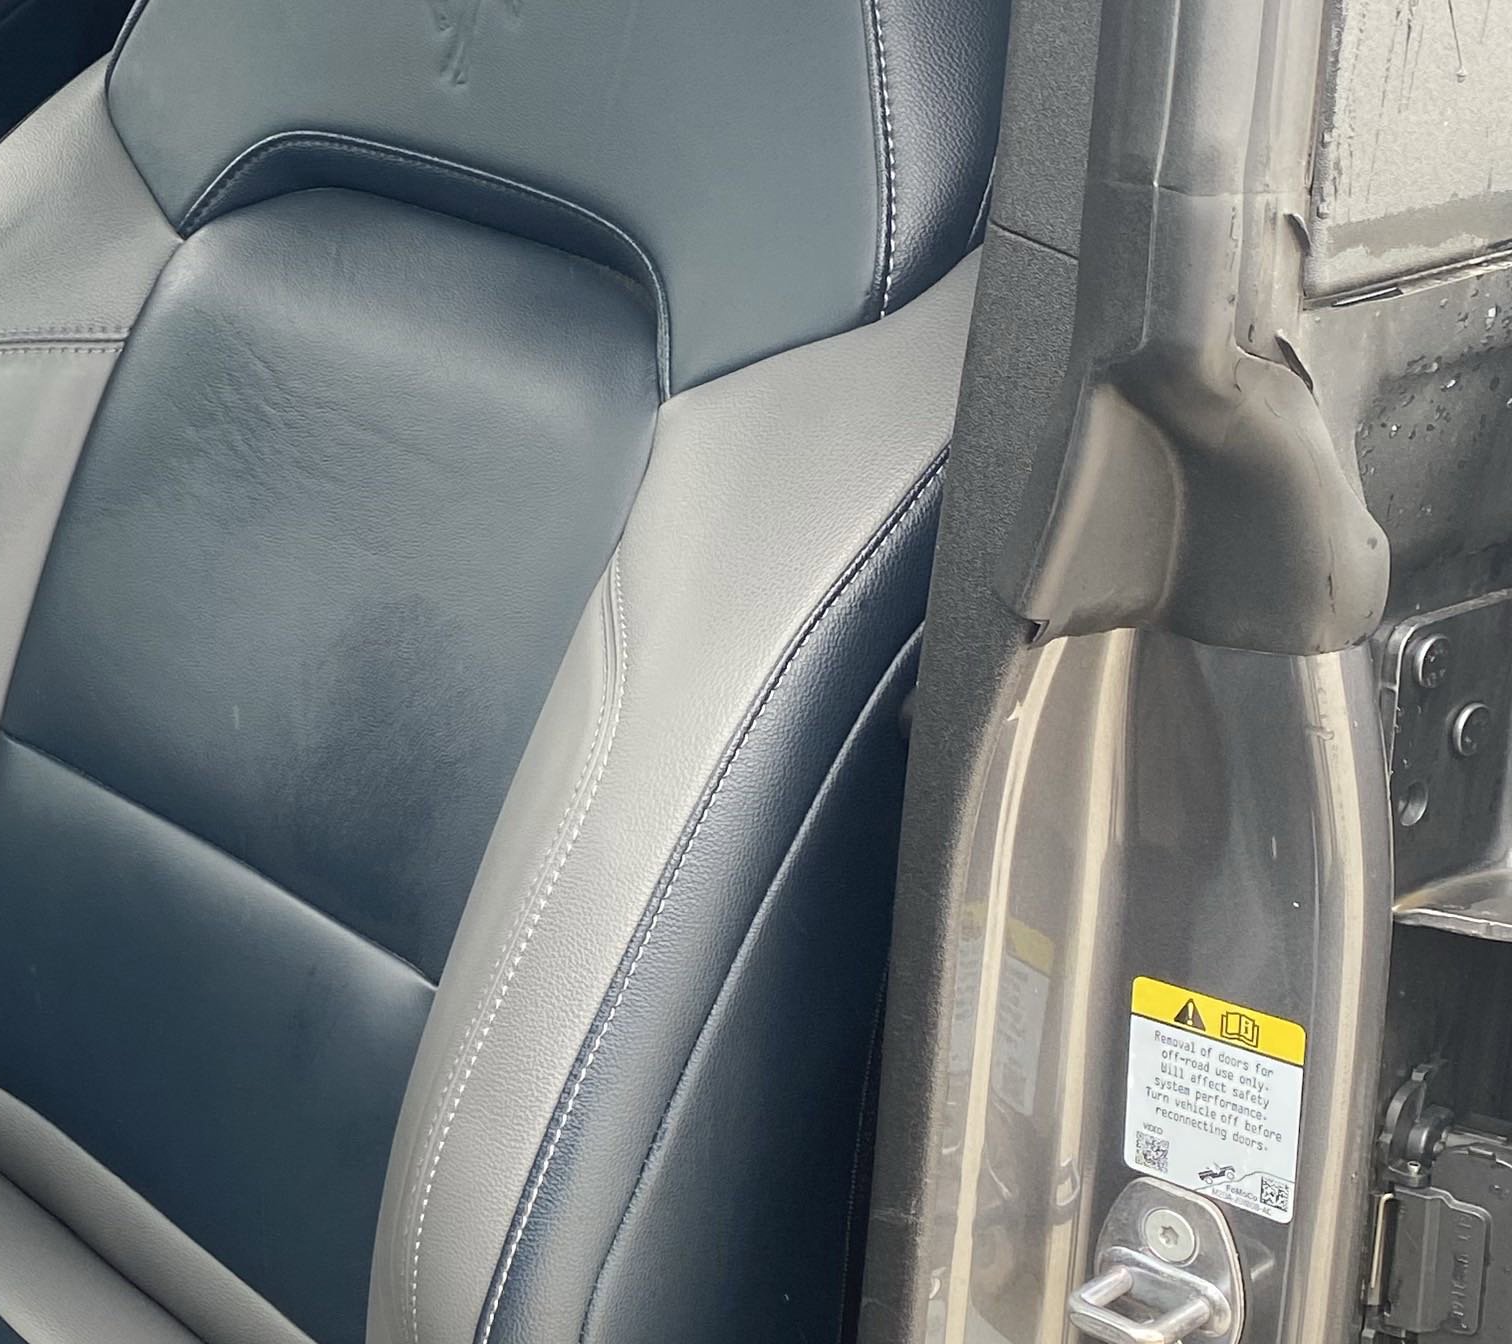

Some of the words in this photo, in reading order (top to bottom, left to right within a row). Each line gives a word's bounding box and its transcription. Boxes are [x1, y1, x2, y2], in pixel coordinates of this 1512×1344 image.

[1154, 1029, 1196, 1054] Removal
[1200, 1044, 1212, 1059] of
[1218, 1051, 1249, 1071] doors
[1255, 1063, 1274, 1079] for
[1161, 1048, 1209, 1073] off-road
[1215, 1066, 1233, 1081] use
[1154, 1075, 1190, 1098] system
[1190, 1072, 1225, 1093] affect
[1232, 1085, 1270, 1110] safety
[1145, 1085, 1169, 1104] Turn
[1175, 1095, 1216, 1120] vehicle
[1220, 1111, 1237, 1128] off
[1244, 1119, 1282, 1143] before
[1155, 1105, 1227, 1141] reconnecting
